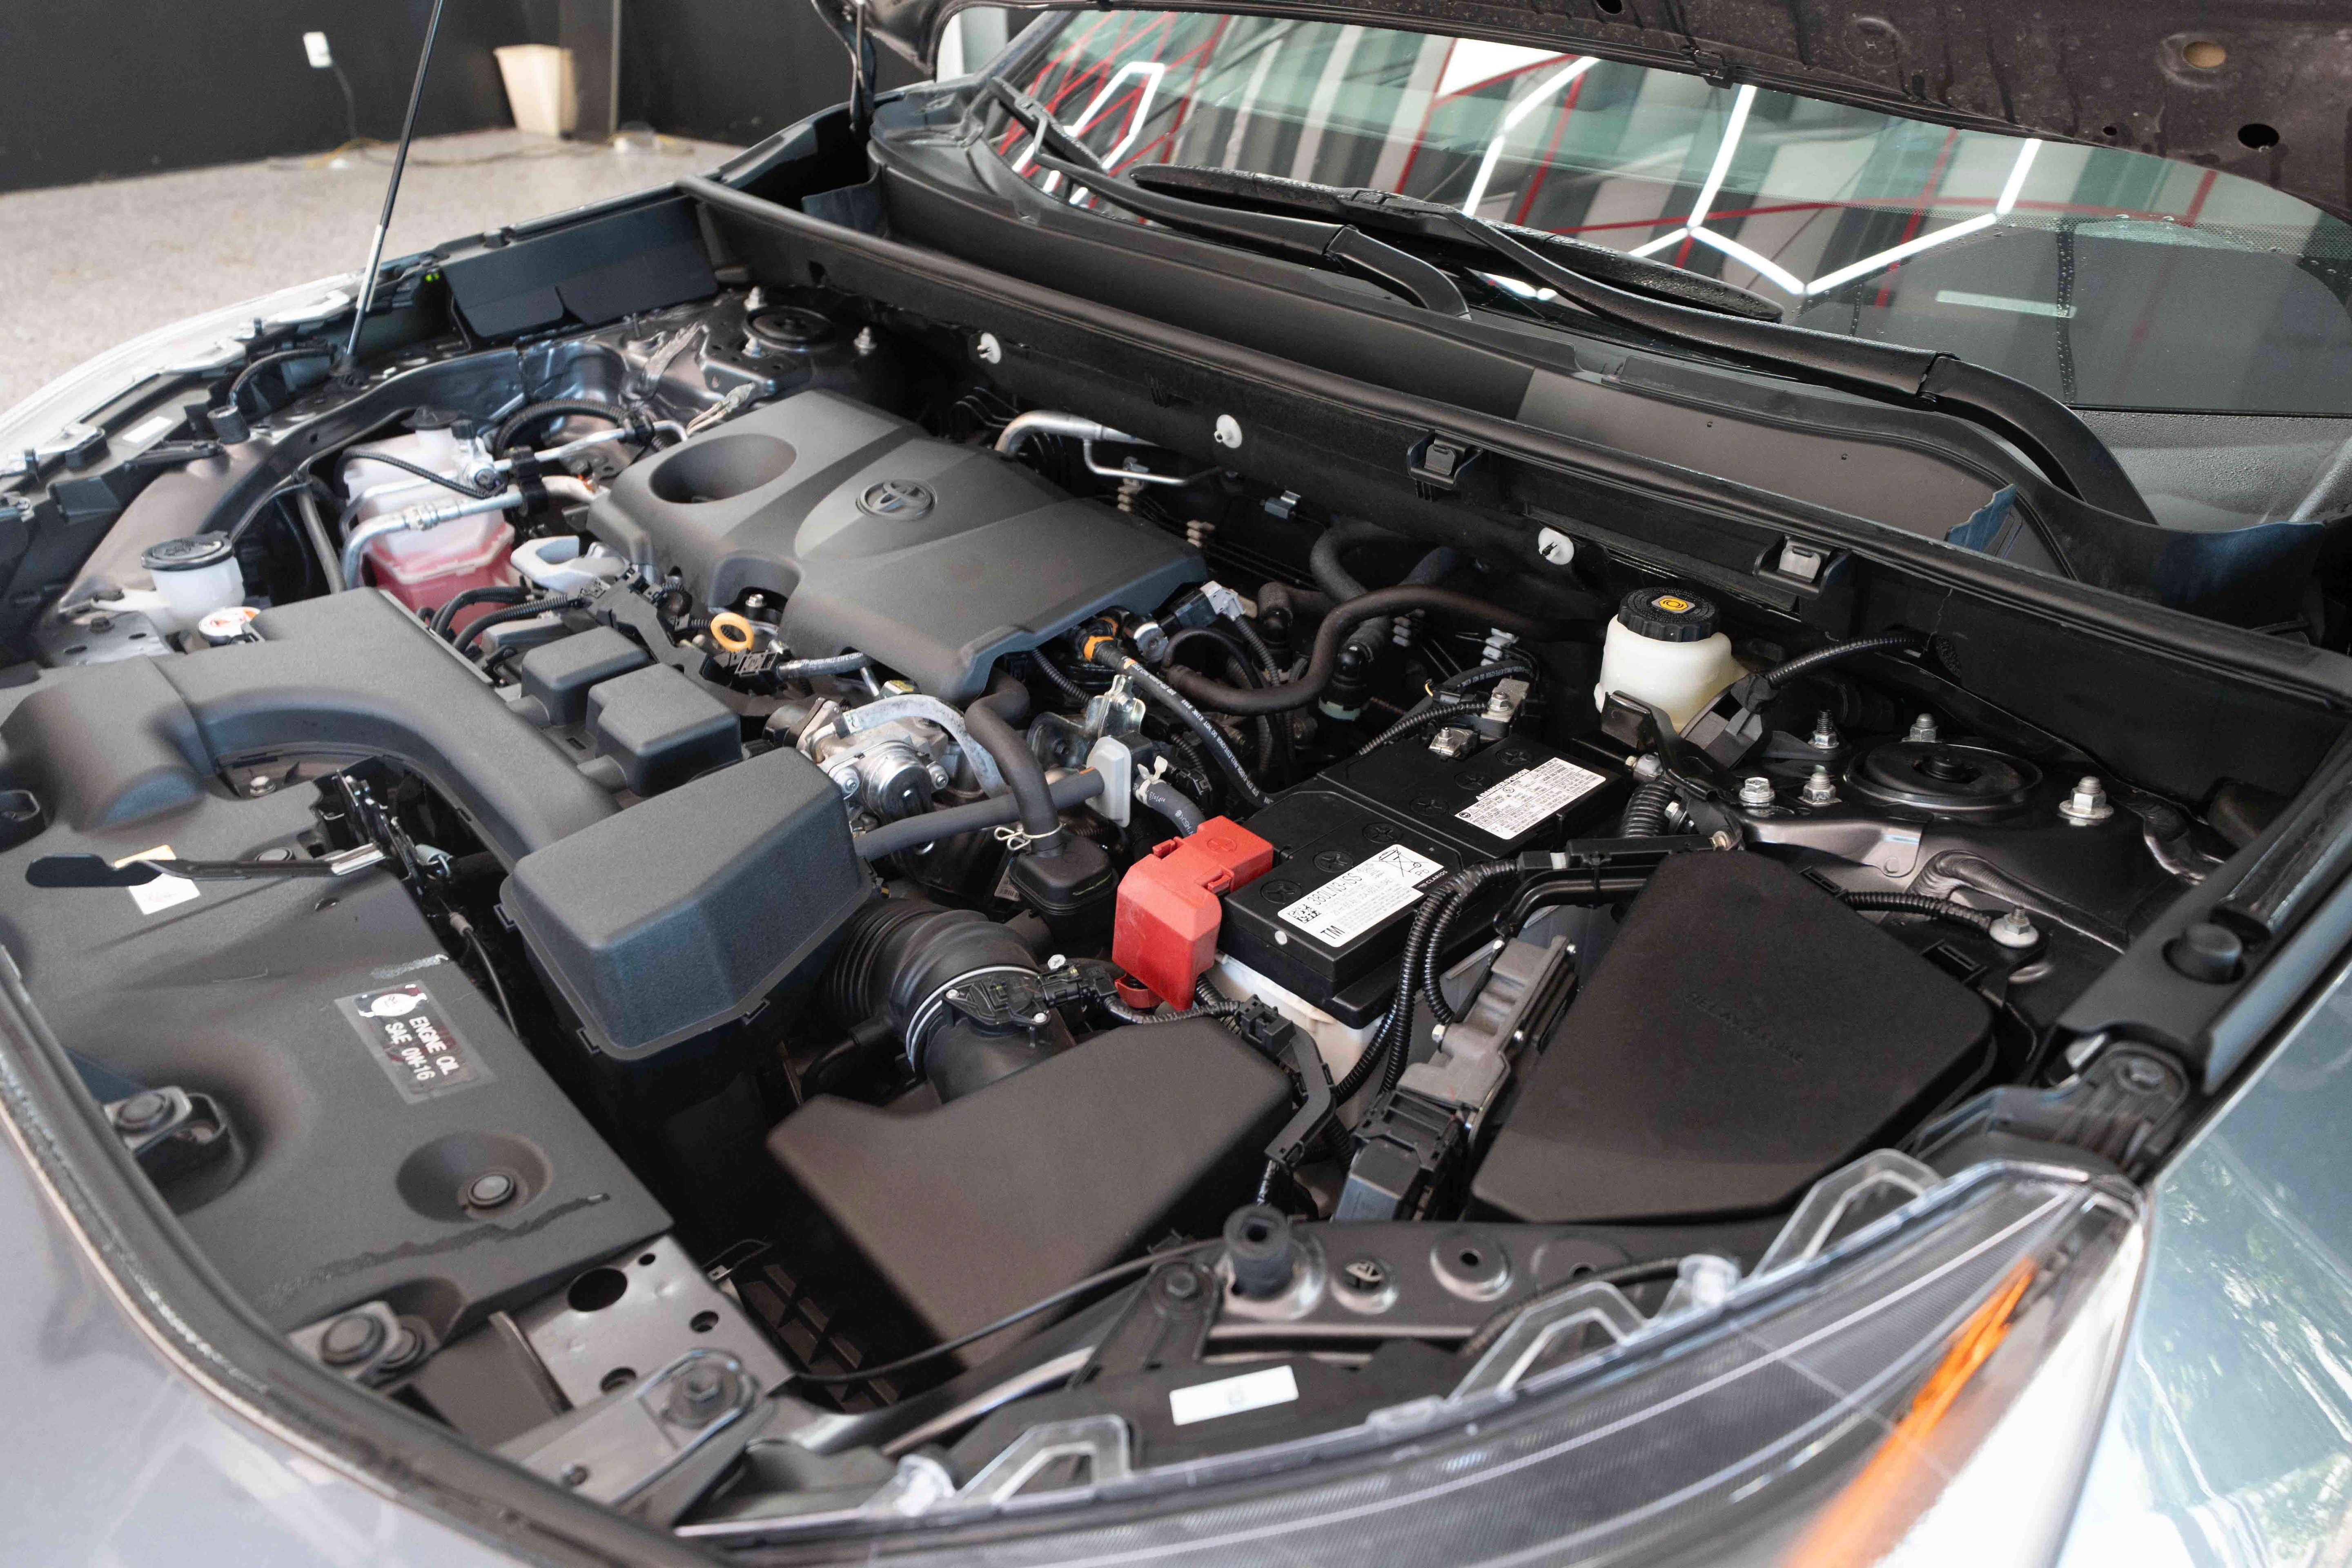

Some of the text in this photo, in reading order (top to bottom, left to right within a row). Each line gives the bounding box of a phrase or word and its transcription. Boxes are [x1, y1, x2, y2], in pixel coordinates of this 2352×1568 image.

[1425, 870, 1448, 884] CLARIOS
[1320, 925, 1345, 940] TM
[385, 1022, 436, 1081] SAE 0W-16
[409, 1016, 460, 1076] ENGINE OIL
